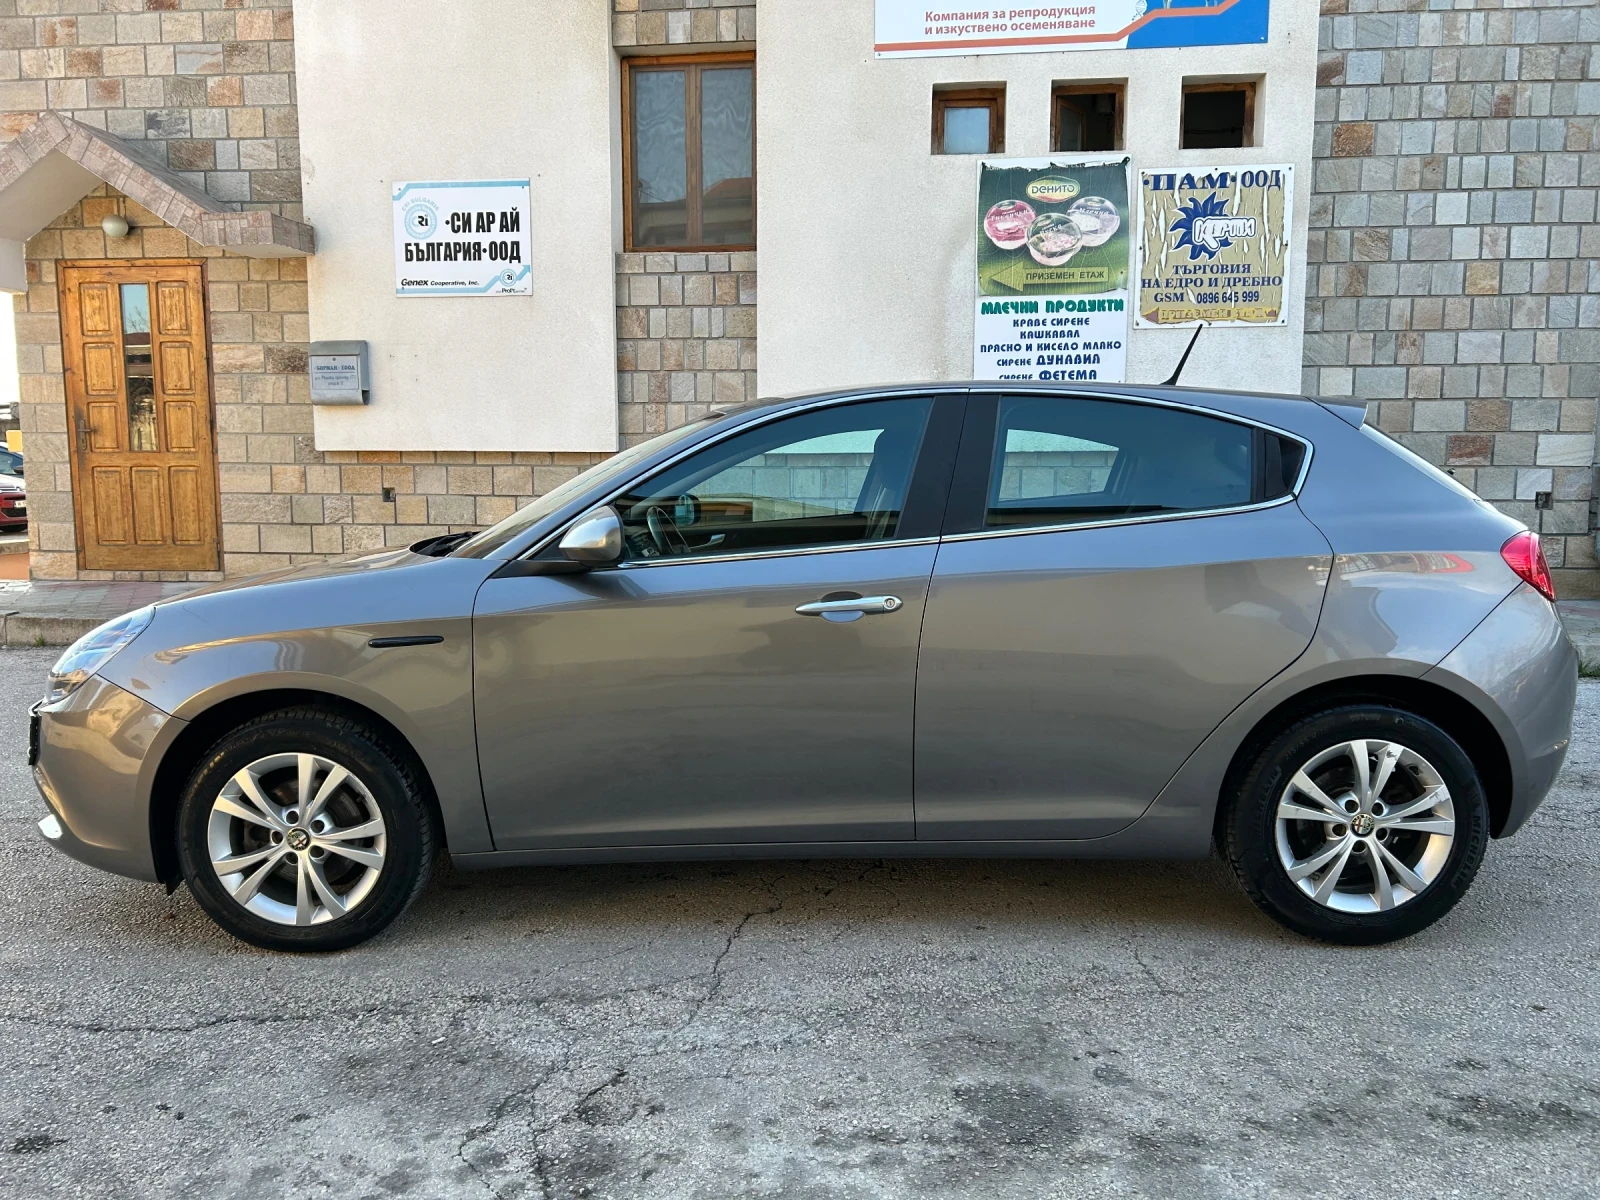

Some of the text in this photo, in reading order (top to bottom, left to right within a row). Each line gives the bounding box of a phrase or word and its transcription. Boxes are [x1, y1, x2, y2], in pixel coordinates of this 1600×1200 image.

[925, 5, 1096, 23] Компания за репродукция
[925, 18, 1095, 36] и изкуствено осеменяване
[1241, 170, 1282, 191] ООД
[475, 211, 496, 233] АР
[499, 206, 520, 233] АЙ
[1025, 270, 1105, 281] ПРИЗЕМЕН ЕТАЖ
[1172, 263, 1251, 275] ТЪРГОВИЯ
[401, 278, 429, 287] Genex
[1141, 276, 1283, 290] НА ЕДРО И ДРЕБНО
[1153, 290, 1260, 304] GSM 0896 645 999
[981, 298, 1124, 315] МЛЕЧНИ ПРОДУКТИ
[1012, 317, 1090, 328] КРАВЕ СИРЕНЕ
[1020, 329, 1080, 339] КАШКАВАЛ
[980, 340, 1122, 353] ПРЯСНО И КИСЕЛО МЛЯКО
[996, 358, 1032, 367] СИРЕНЕ
[1038, 369, 1097, 381] ФЕТЕМА
